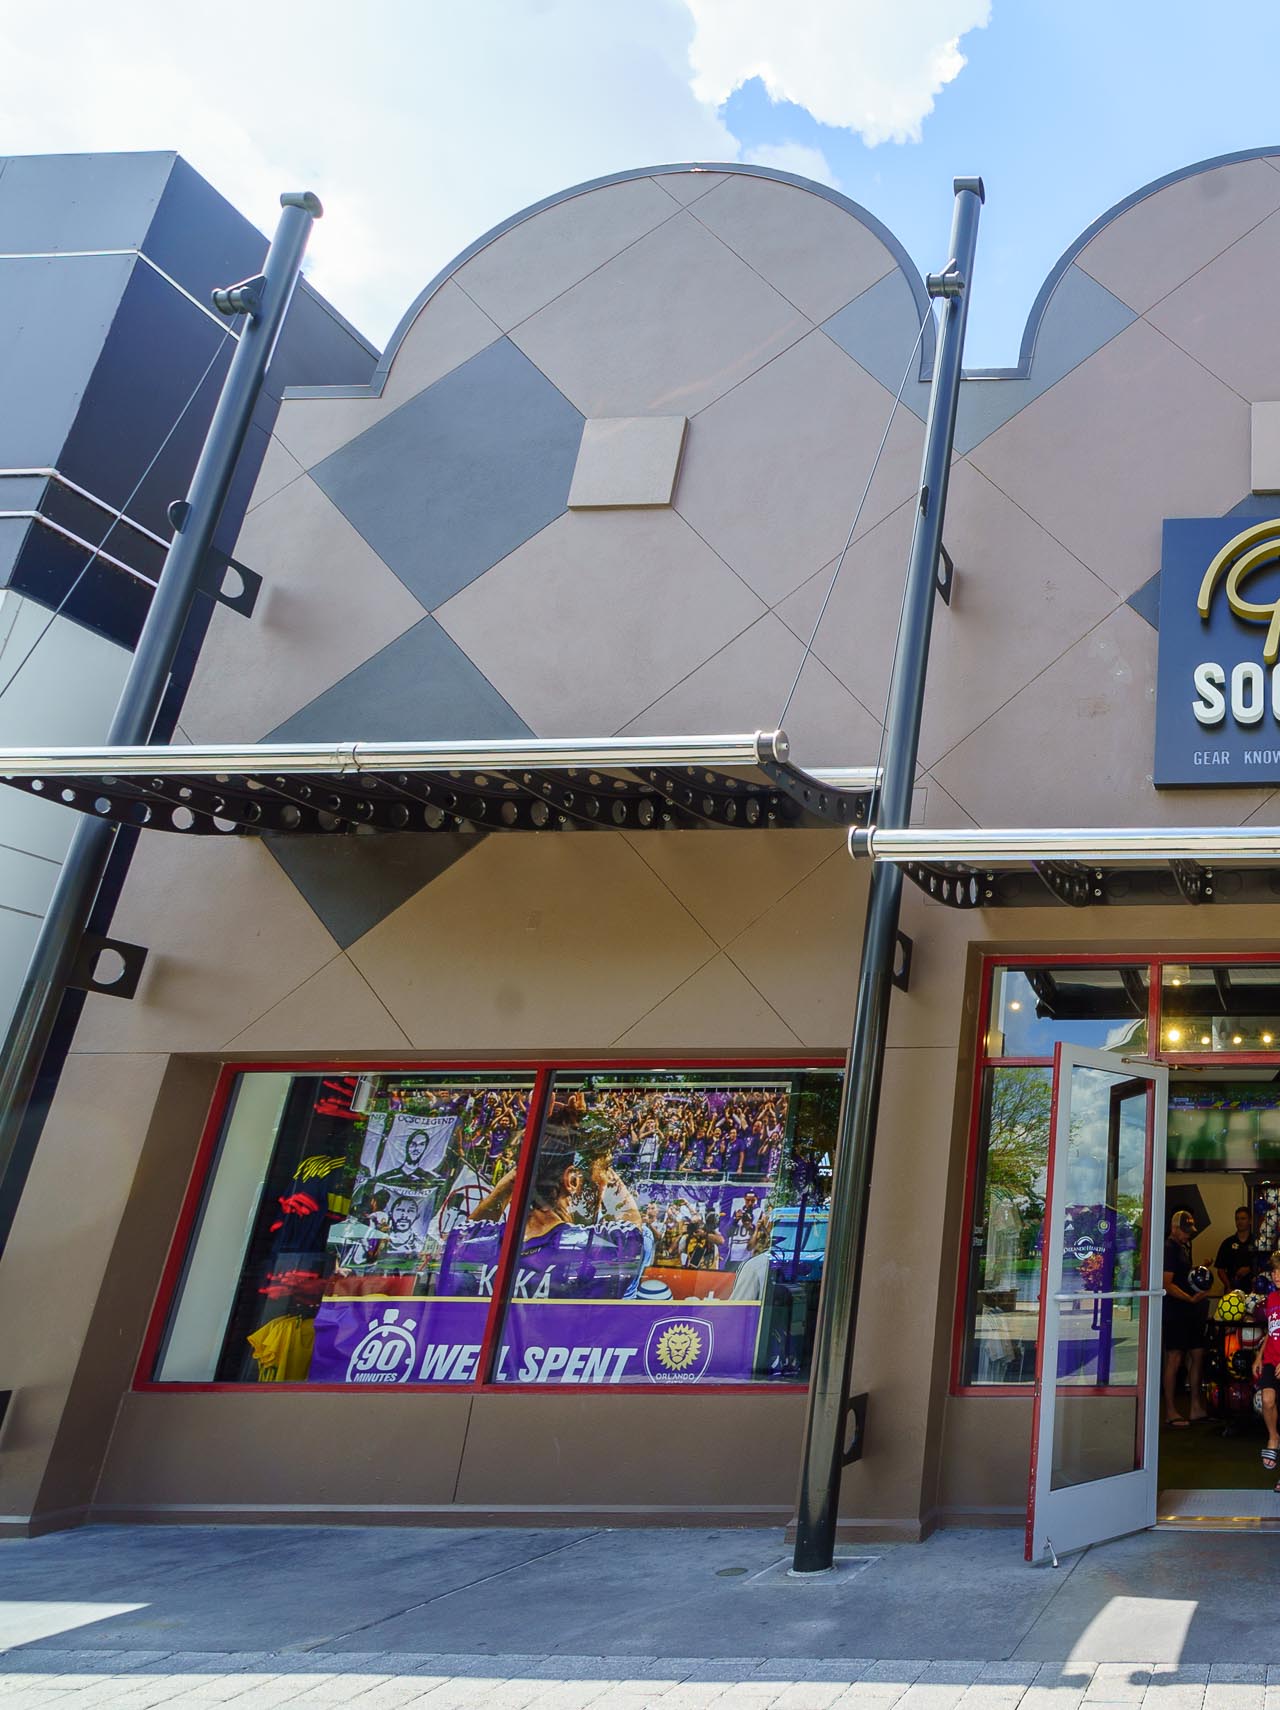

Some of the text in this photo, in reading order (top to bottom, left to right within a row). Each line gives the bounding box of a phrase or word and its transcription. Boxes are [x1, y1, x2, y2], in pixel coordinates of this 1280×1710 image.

[1193, 751, 1230, 765] GEAR
[422, 1117, 455, 1125] LEGEND
[478, 1264, 556, 1299] KKÁ
[356, 1339, 406, 1371] 90
[418, 1344, 638, 1383] WEL SPENT
[353, 1373, 398, 1382] MINUTES
[655, 1372, 695, 1380] ORLANDO
